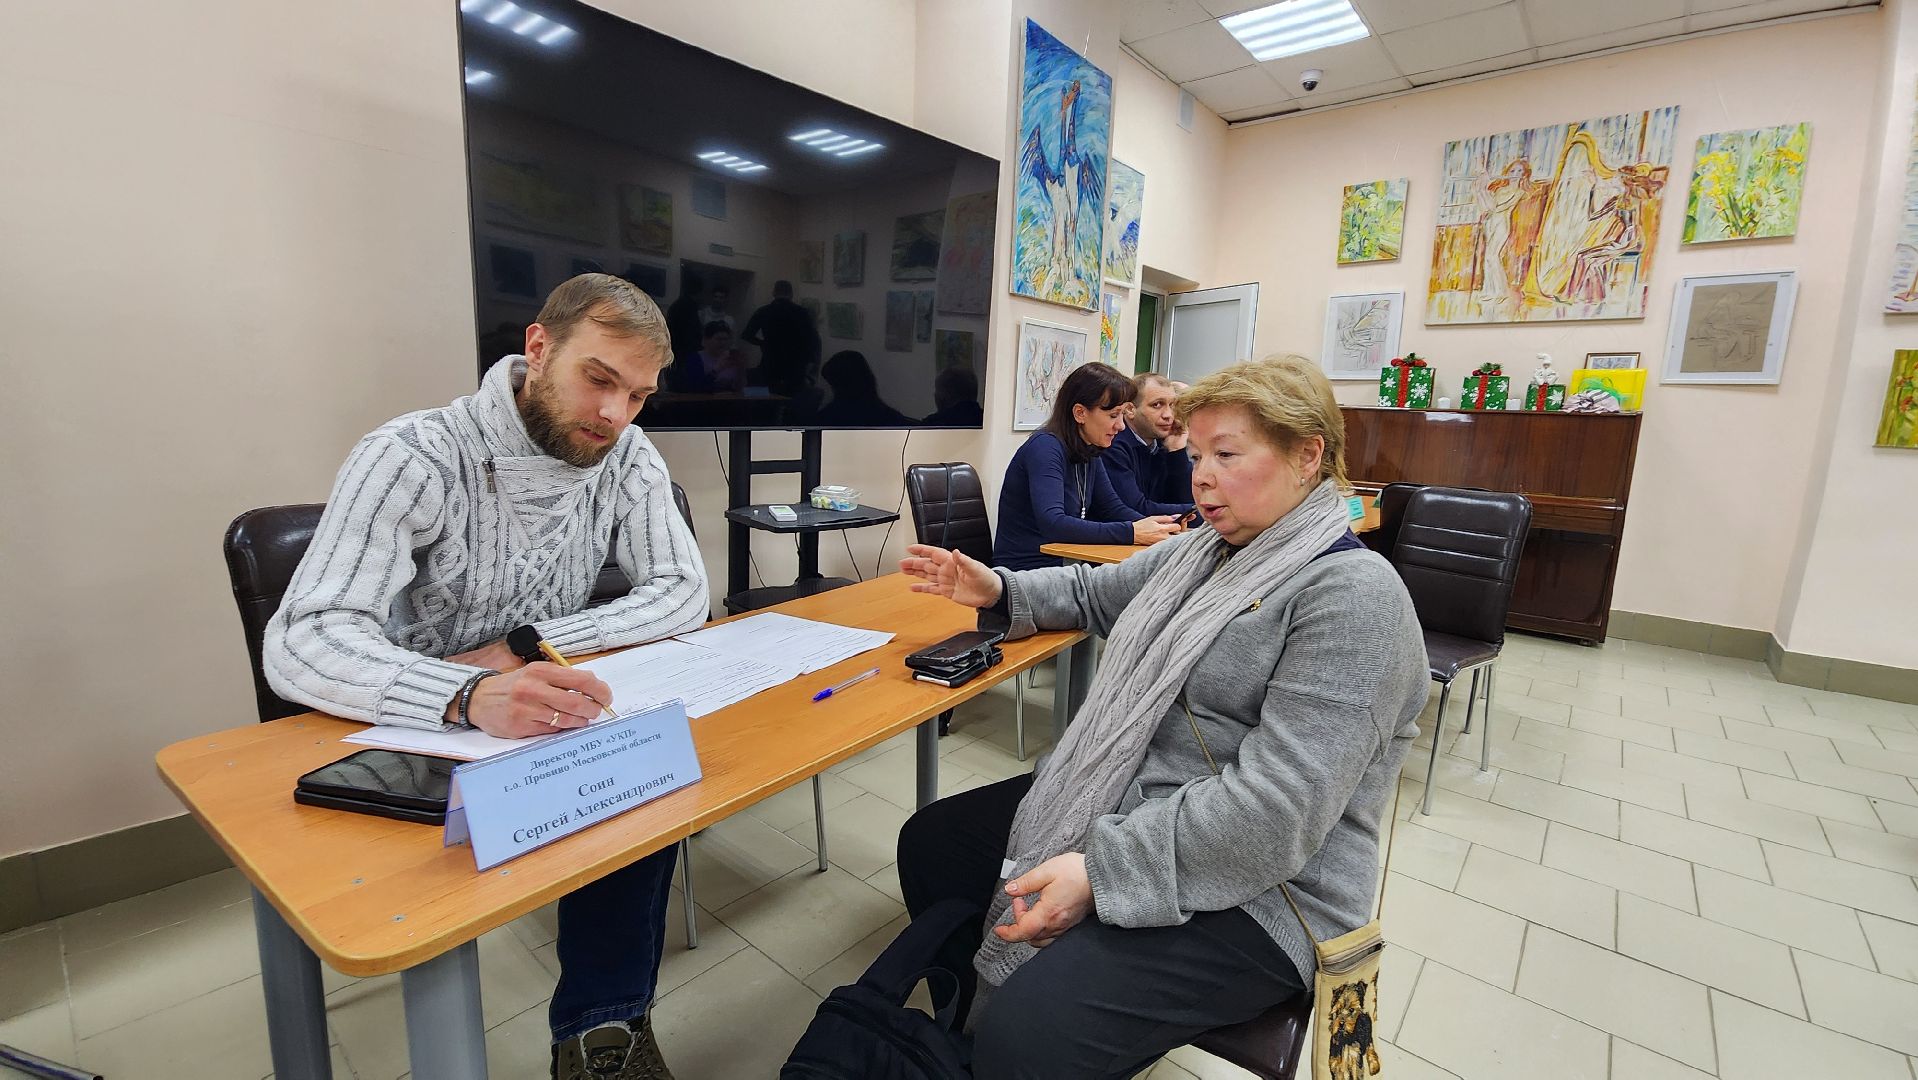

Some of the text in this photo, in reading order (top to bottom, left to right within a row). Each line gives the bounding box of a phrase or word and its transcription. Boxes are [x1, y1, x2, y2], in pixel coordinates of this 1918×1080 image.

[504, 782, 522, 793] г.о.
[572, 743, 628, 769] Московской
[629, 732, 662, 749] области
[530, 729, 637, 772] Директор МБУ «УКП»
[513, 771, 675, 844] Сергей Александрович
[578, 776, 615, 798] Соин
